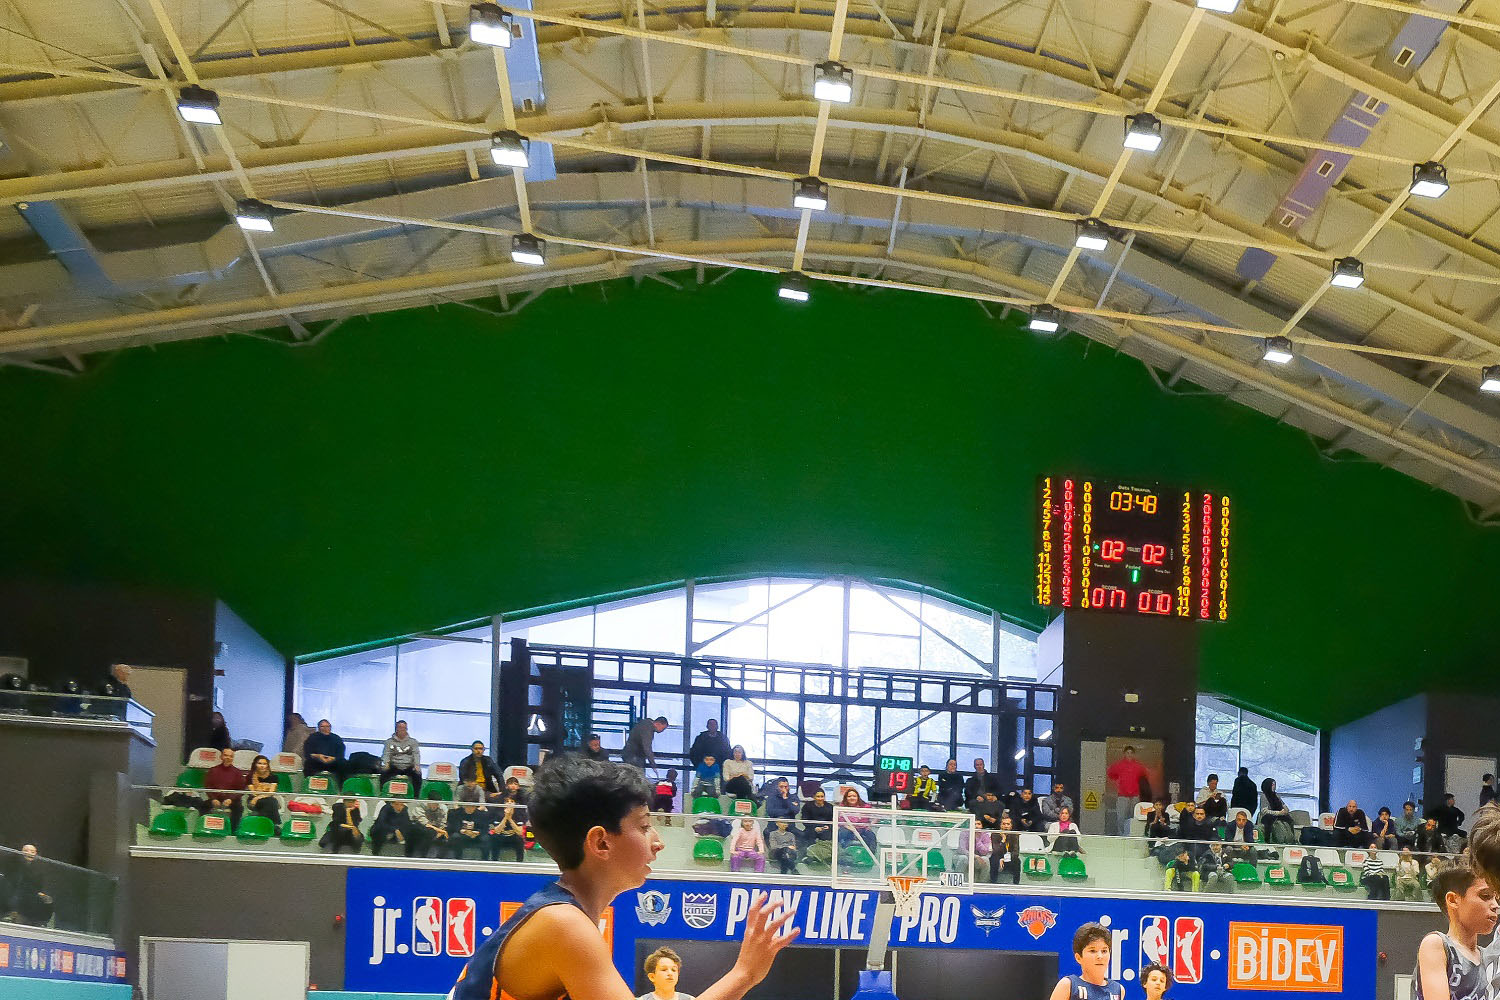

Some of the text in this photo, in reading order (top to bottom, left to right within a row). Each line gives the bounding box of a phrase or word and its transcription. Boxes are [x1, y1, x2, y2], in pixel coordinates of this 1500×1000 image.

[1044, 478, 1051, 488] 1
[1043, 488, 1051, 498] 2
[1184, 492, 1190, 502] 1
[1043, 499, 1051, 509] 4
[1182, 502, 1190, 512] 2
[1043, 509, 1051, 519] 5
[1182, 513, 1190, 523] 3
[1043, 520, 1051, 530] 7
[1182, 524, 1190, 533] 4
[1043, 531, 1051, 540] 8
[1182, 534, 1190, 544] 5
[1044, 542, 1052, 552] 9
[1101, 540, 1124, 561] 02
[1182, 544, 1190, 554] 6
[1038, 552, 1050, 563] 11
[1142, 544, 1165, 565] 02
[1183, 555, 1191, 564] 7
[1038, 563, 1052, 574] 12
[1182, 566, 1190, 575] 8
[1037, 573, 1051, 584] 13
[1182, 576, 1190, 586] 9
[1037, 584, 1051, 594] 14
[1177, 586, 1190, 596] 10
[1037, 594, 1051, 605] 15
[1178, 596, 1188, 606] 11
[1177, 606, 1190, 616] 12
[889, 772, 909, 790] 19
[948, 873, 963, 886] NBA
[684, 907, 715, 915] KINGS
[805, 891, 869, 940] LIKE
[899, 896, 961, 944] PRO
[369, 896, 409, 965] jr.
